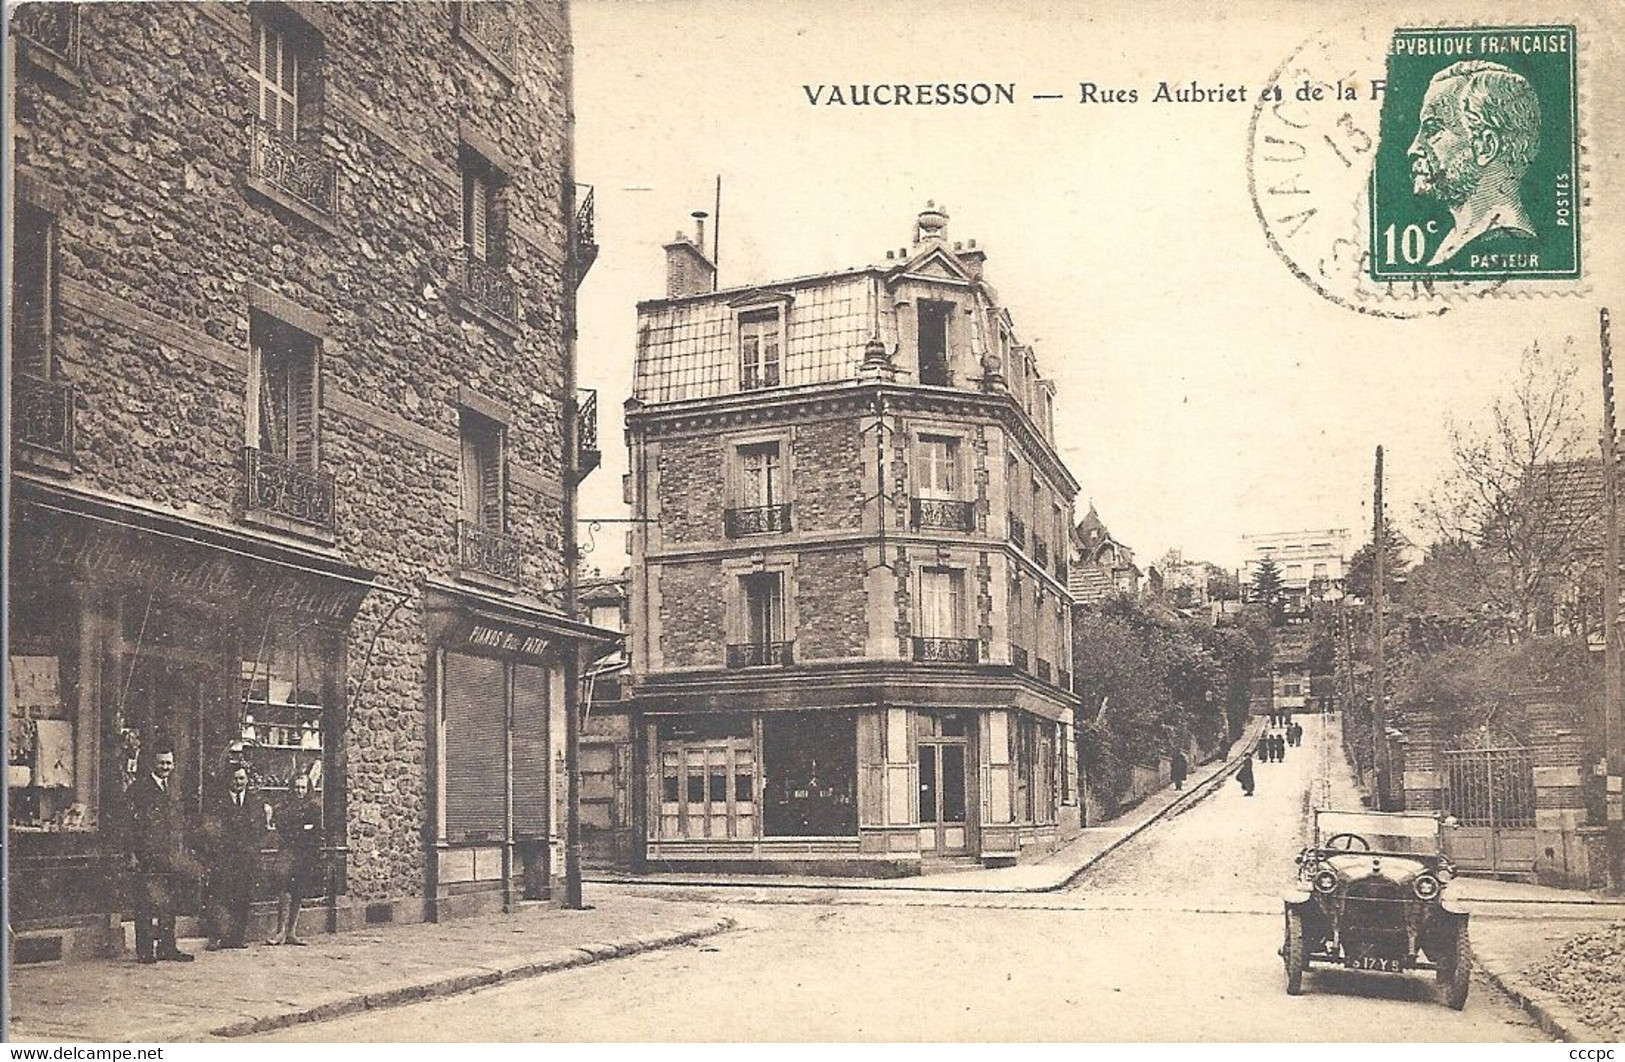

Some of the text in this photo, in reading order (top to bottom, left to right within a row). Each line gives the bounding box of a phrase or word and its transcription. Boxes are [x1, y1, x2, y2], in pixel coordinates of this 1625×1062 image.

[1481, 34, 1566, 55] FRANÇAISE
[802, 83, 1016, 106] VAUCRESSON
[1079, 82, 1138, 104] Rues
[1152, 80, 1247, 103] Aubriet
[1261, 85, 1283, 101] et
[1295, 81, 1324, 101] de
[1337, 80, 1358, 101] la
[1370, 79, 1387, 101] F
[1556, 173, 1570, 227] POSTES
[1470, 254, 1539, 269] PASTEUR
